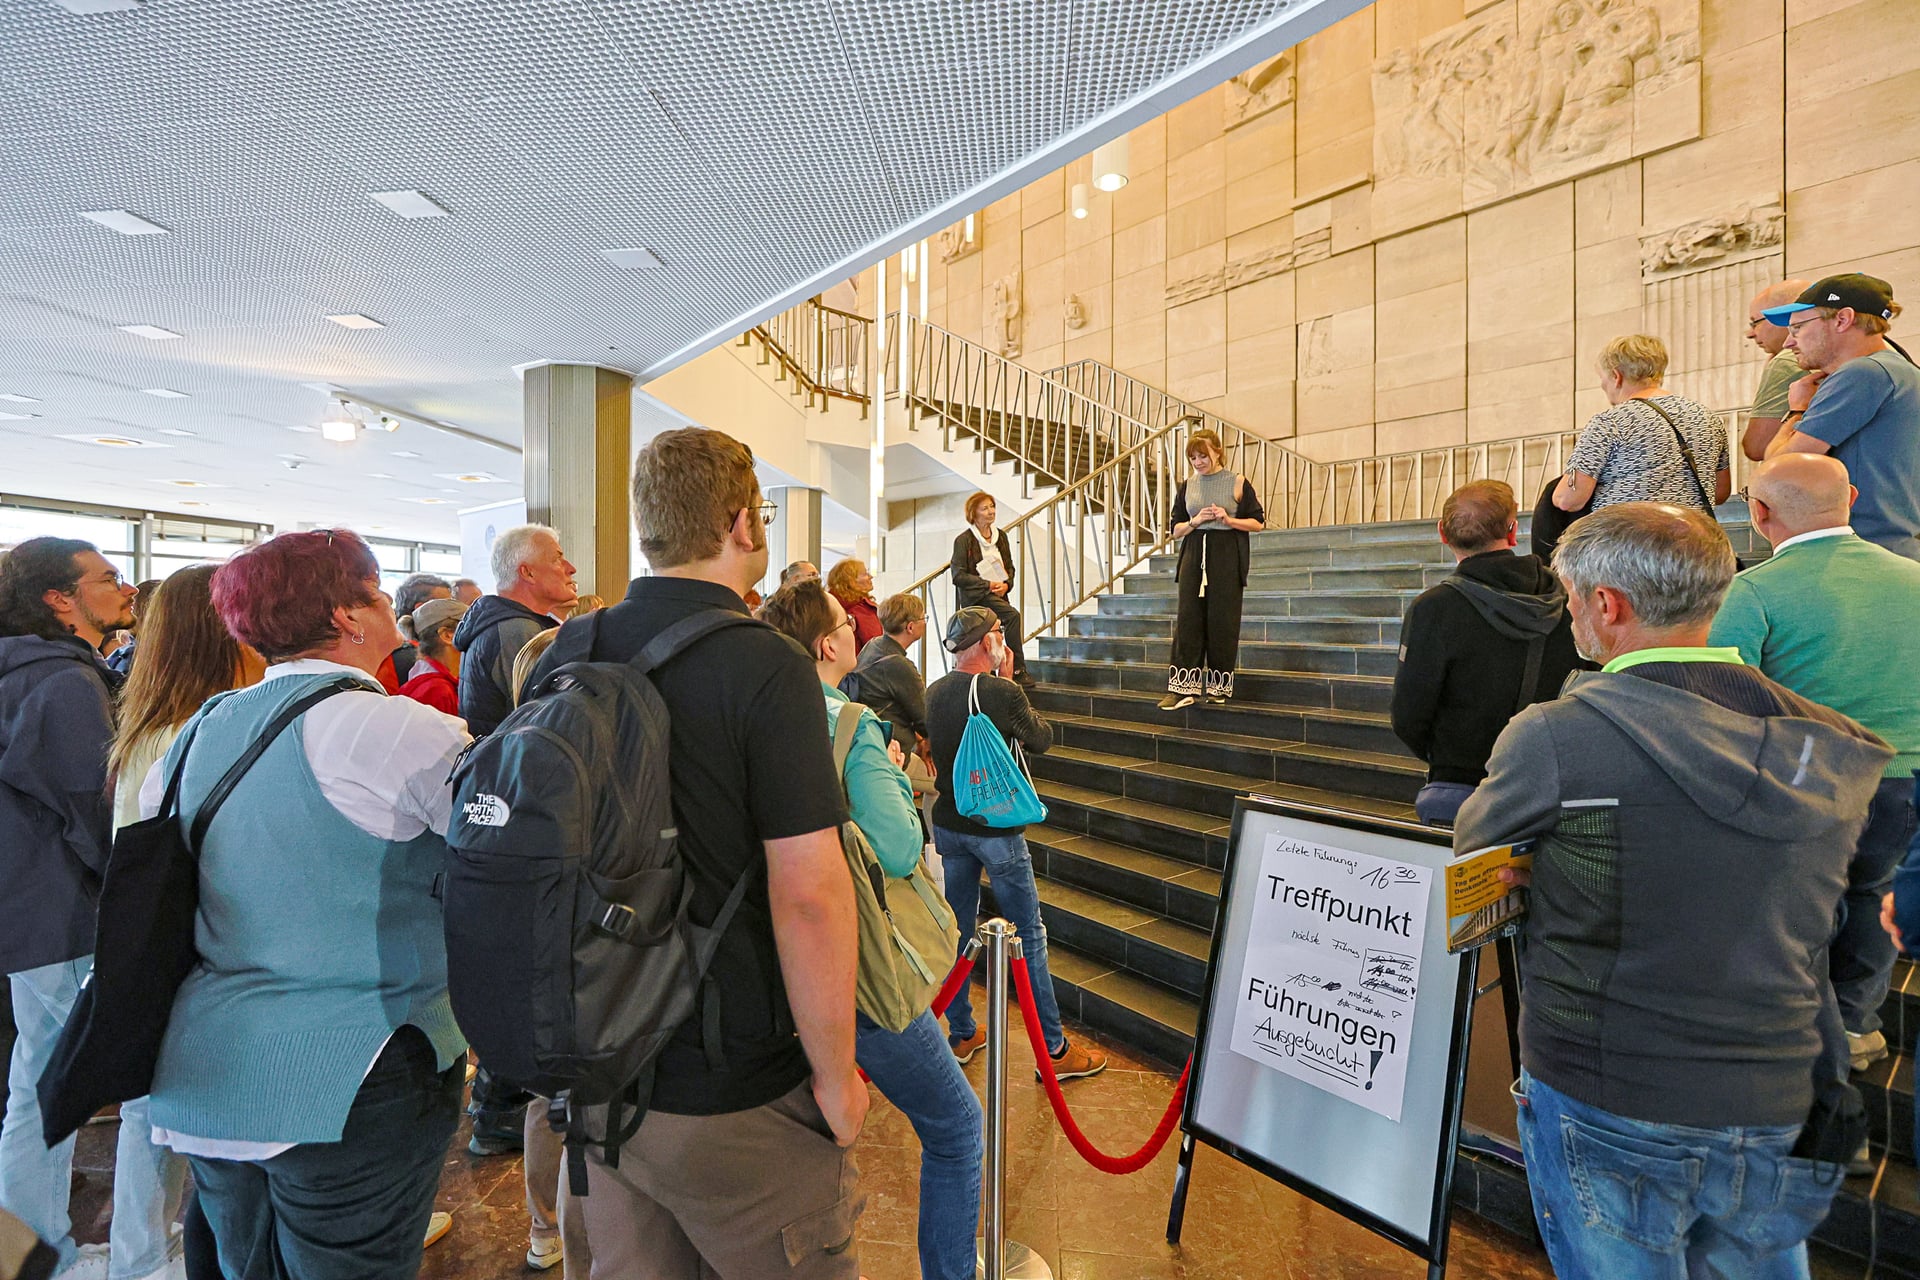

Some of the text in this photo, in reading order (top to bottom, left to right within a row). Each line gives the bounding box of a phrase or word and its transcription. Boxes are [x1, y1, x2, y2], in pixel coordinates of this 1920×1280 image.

[476, 793, 495, 805] THE
[462, 802, 494, 816] NORTH
[466, 814, 492, 826] FACE
[1276, 840, 1310, 857] Letzte
[1267, 874, 1413, 937] Treffpunkt
[1247, 977, 1397, 1055] Führungen
